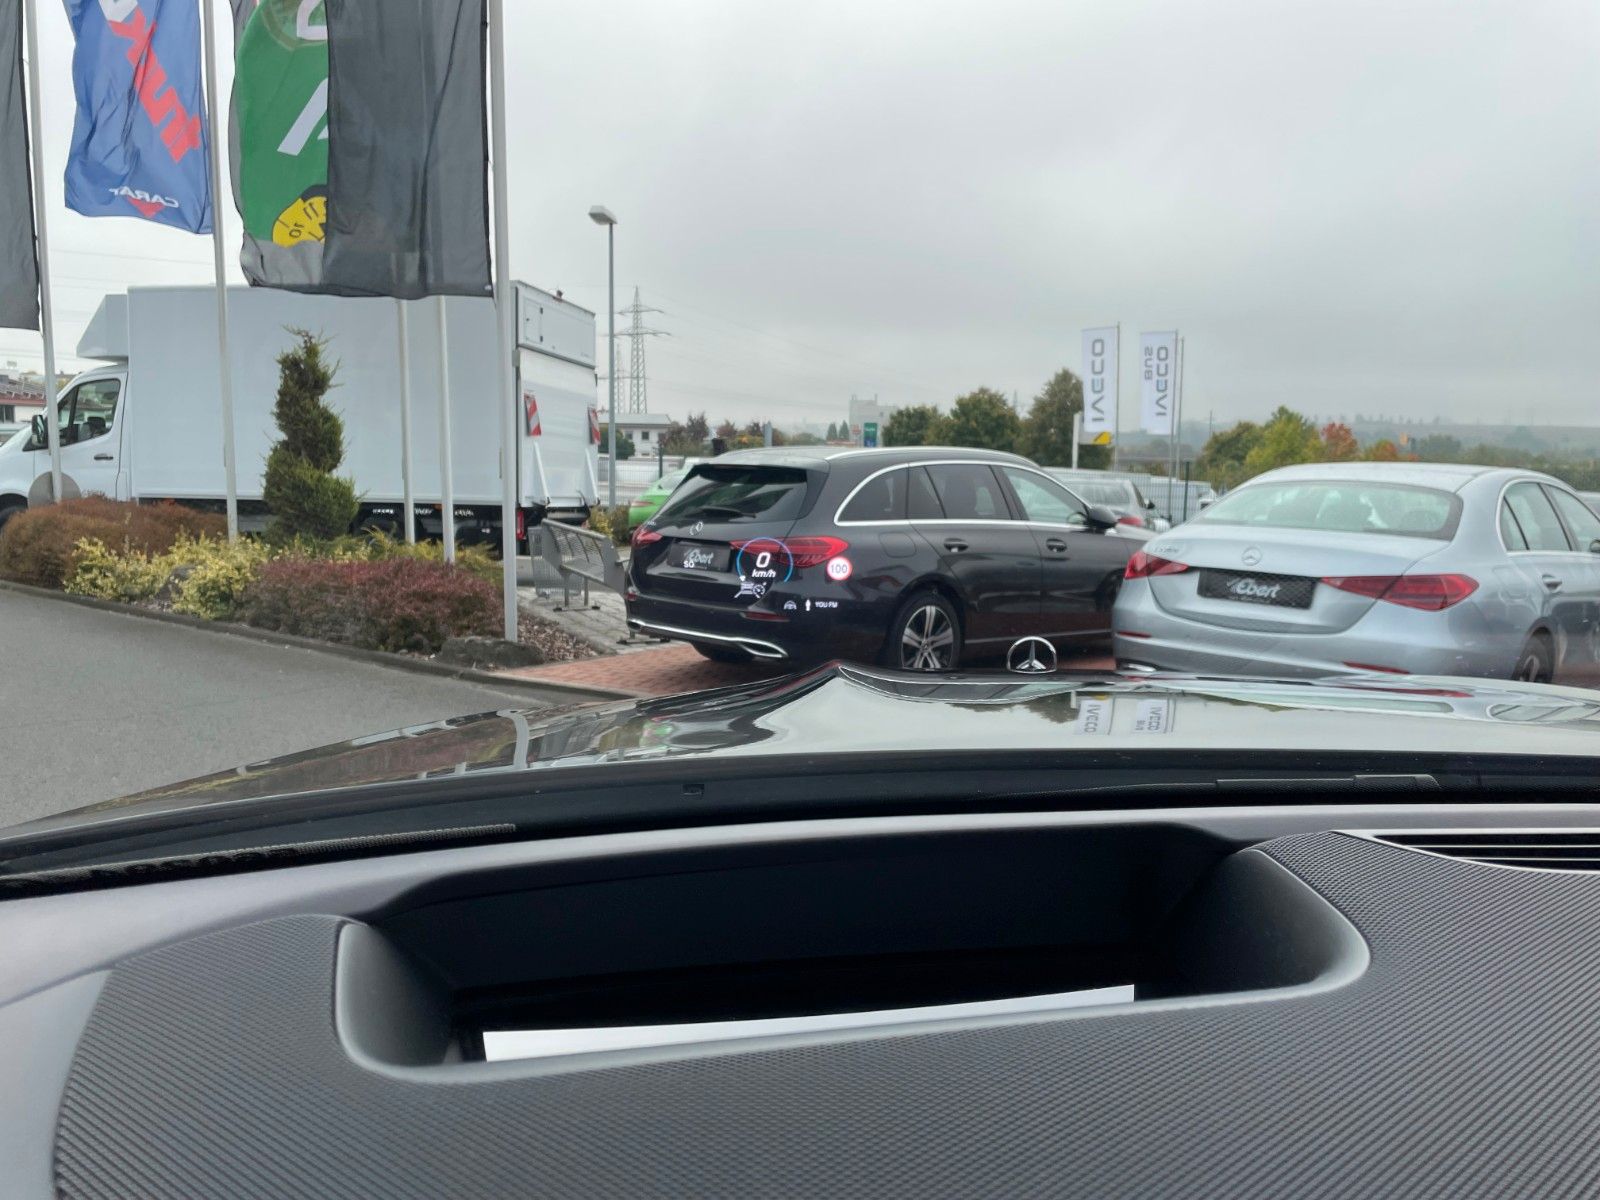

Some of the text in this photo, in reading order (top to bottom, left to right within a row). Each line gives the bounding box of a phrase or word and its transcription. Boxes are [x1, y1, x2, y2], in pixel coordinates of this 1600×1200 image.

[756, 552, 771, 568] 0
[751, 569, 777, 578] km/h
[831, 563, 848, 574] 100
